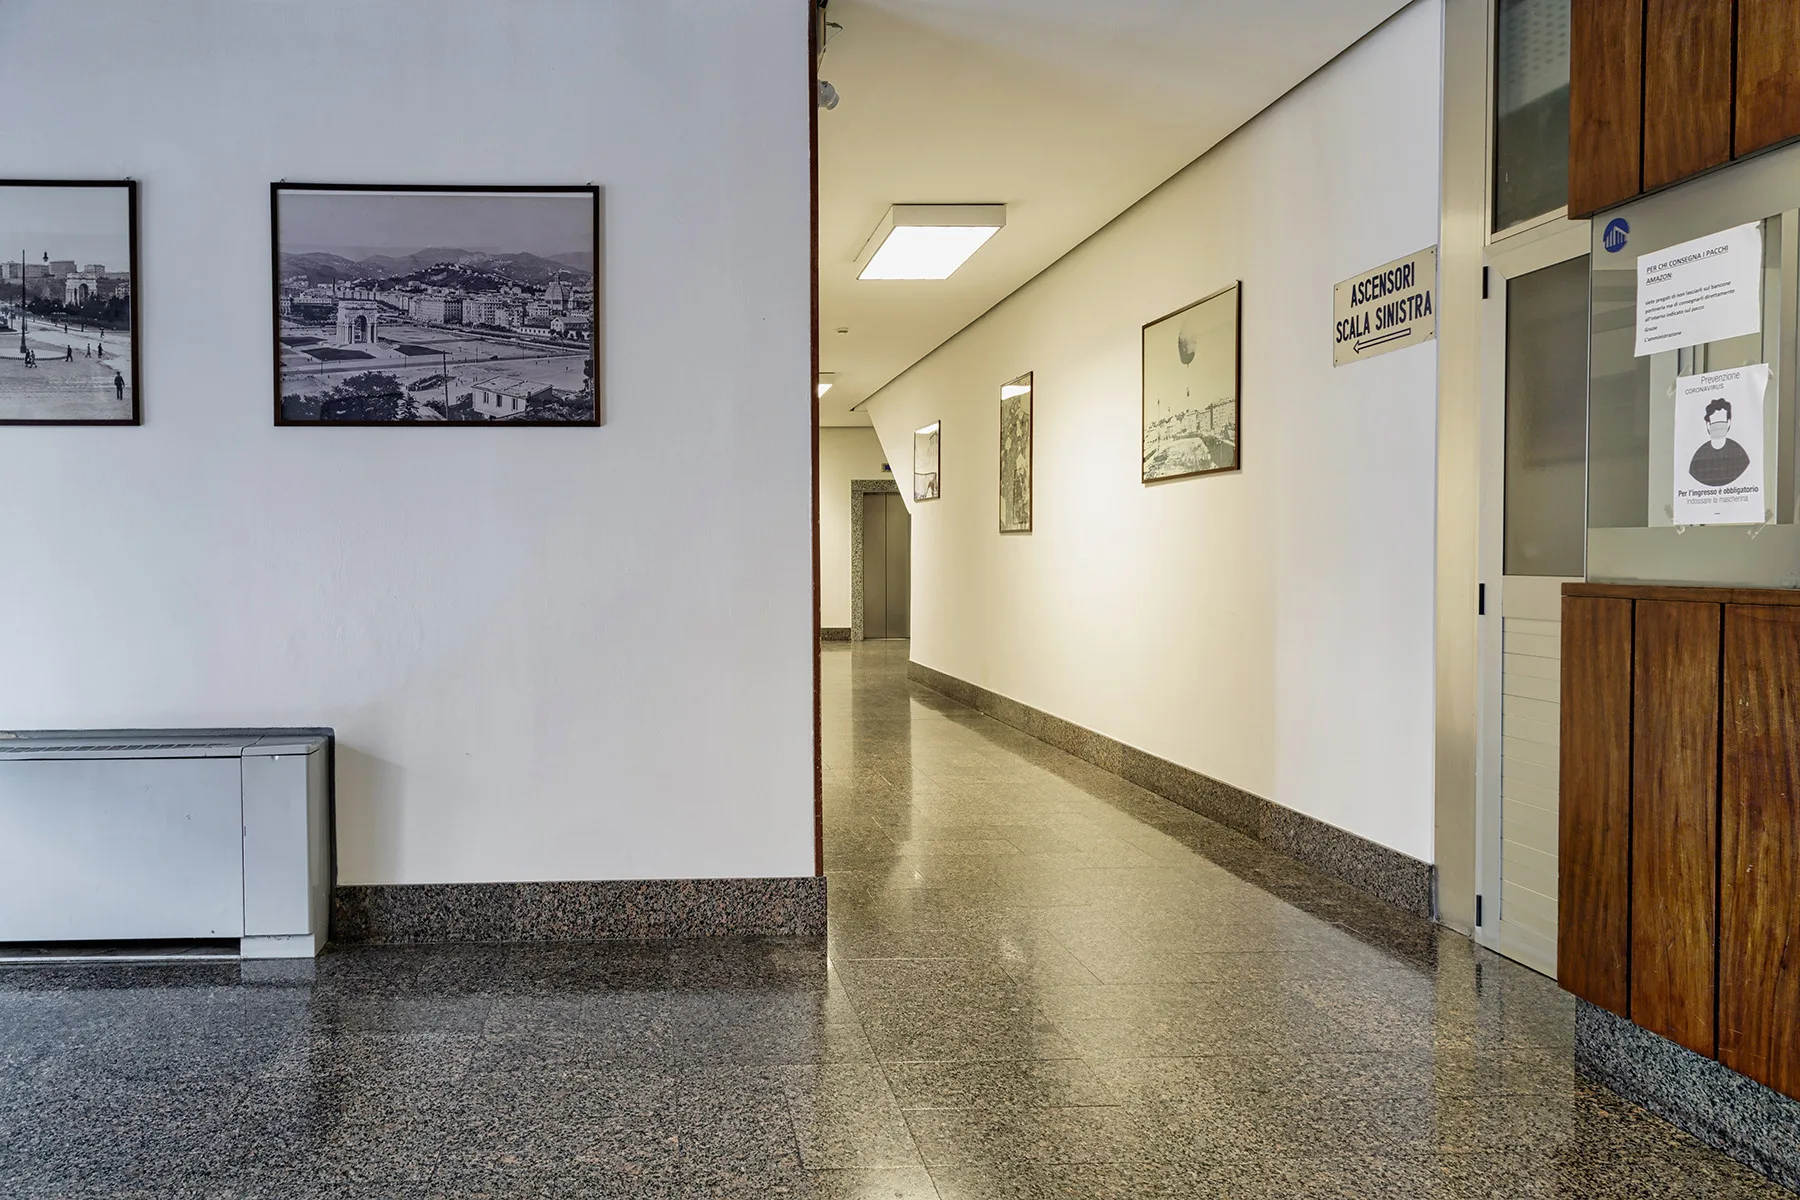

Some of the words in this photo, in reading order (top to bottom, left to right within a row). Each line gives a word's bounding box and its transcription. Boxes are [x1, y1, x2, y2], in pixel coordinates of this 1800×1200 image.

[1646, 264, 1657, 273] PER
[1658, 262, 1668, 270] CHI
[1668, 252, 1701, 267] CONSEGNA
[1706, 244, 1729, 257] PACCHI
[1351, 261, 1415, 308] ASCENSORI
[1646, 272, 1673, 284] AMAZON
[1656, 295, 1671, 304] pregati
[1711, 281, 1731, 290] bancone
[1645, 305, 1665, 315] portineria
[1704, 289, 1735, 300] direttamente
[1336, 311, 1371, 343] SCALA
[1375, 290, 1432, 331] SINISTRA
[1666, 309, 1684, 317] indicato
[1691, 305, 1705, 313] pacco
[1700, 370, 1740, 385] Prevenzione
[1685, 383, 1724, 395] CORONAVIRUS
[1688, 488, 1717, 497] l'ingresso
[1723, 485, 1759, 495] obbligatorio
[1719, 495, 1748, 503] mascherina
